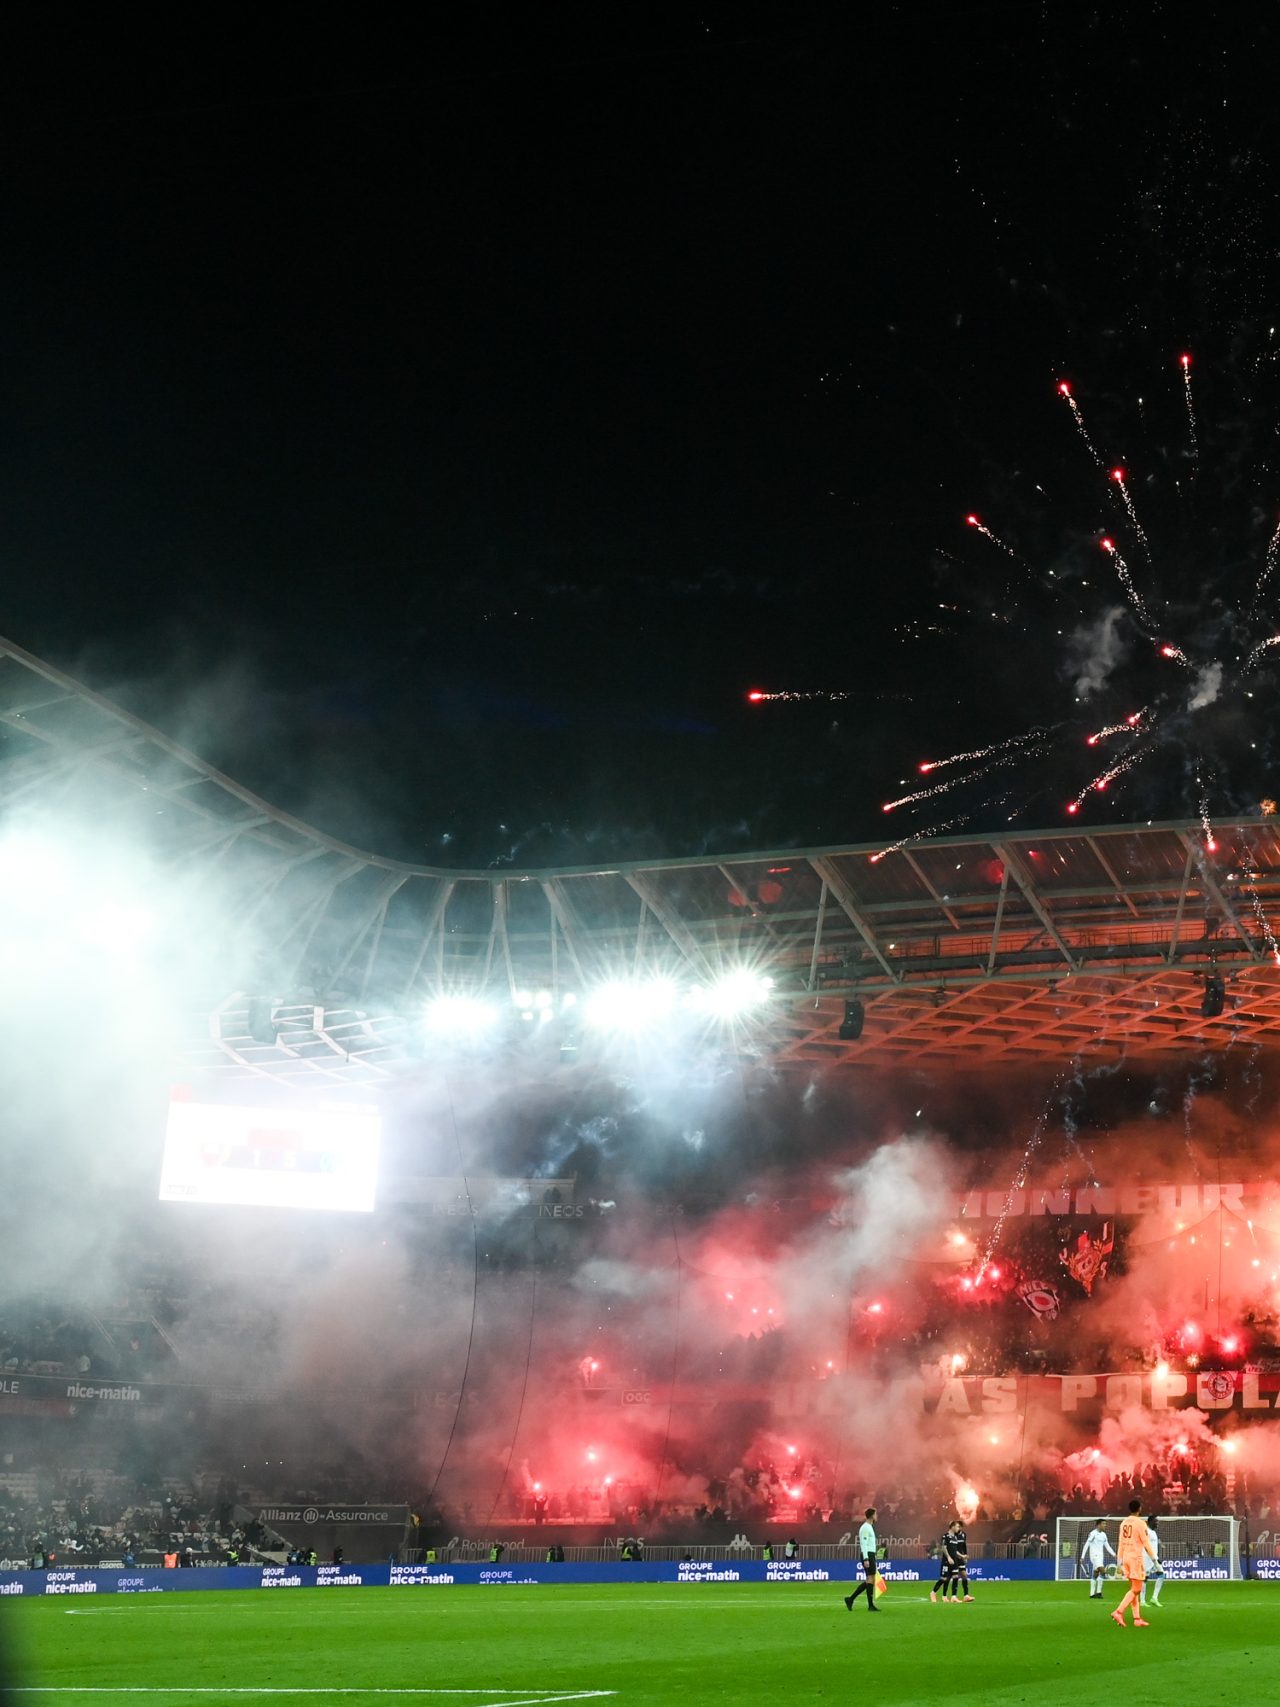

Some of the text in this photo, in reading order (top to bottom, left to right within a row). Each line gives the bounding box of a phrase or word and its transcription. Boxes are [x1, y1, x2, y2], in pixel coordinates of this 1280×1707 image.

[539, 1205, 583, 1217] INEOS
[67, 1383, 140, 1400] nice-matin
[258, 1509, 301, 1522] Allianz
[1123, 1525, 1133, 1538] 80
[679, 1563, 713, 1571] GROUPE
[767, 1562, 802, 1570] GROUPE
[856, 1562, 892, 1570] GUPE
[1162, 1560, 1199, 1568] GROUPE
[263, 1567, 285, 1576] GROUPE
[317, 1566, 340, 1575] GROUPE
[391, 1566, 428, 1575] GROUPE
[480, 1571, 513, 1579] GROUPE
[678, 1569, 740, 1582] nice-matin
[766, 1569, 829, 1581] nice-matin
[856, 1569, 919, 1581] ni-matin
[47, 1572, 76, 1582] GROUPE
[118, 1578, 144, 1587] GROUPE
[261, 1575, 301, 1587] nice-matin
[317, 1574, 362, 1586] nice-matin
[390, 1573, 454, 1585] nice-matin
[46, 1580, 97, 1594] nice-matin
